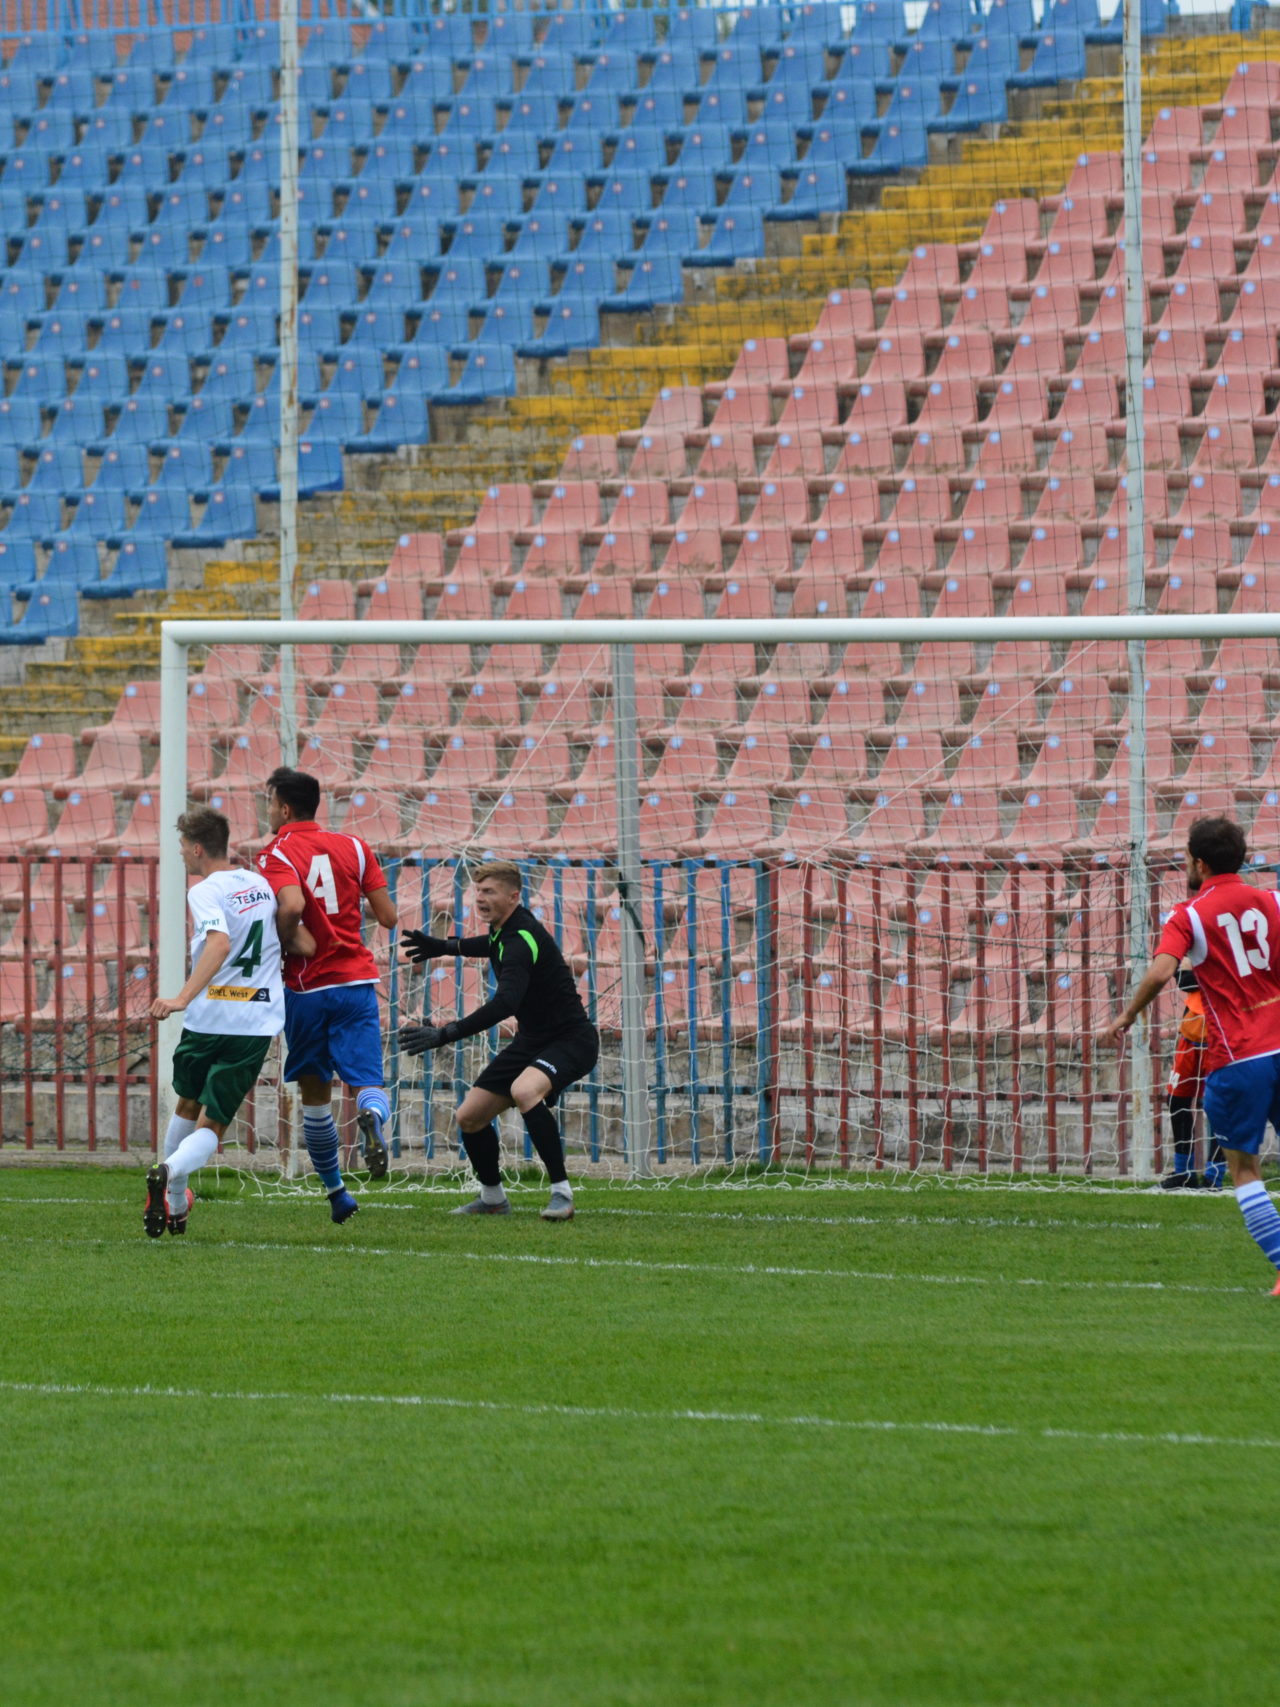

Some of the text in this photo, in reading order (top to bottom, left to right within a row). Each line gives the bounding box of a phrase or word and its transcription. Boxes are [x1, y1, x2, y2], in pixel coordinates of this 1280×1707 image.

[236, 891, 271, 905] TESAN
[305, 853, 340, 915] 4
[230, 919, 264, 978] 4
[1216, 907, 1272, 978] 13
[229, 986, 249, 998] West
